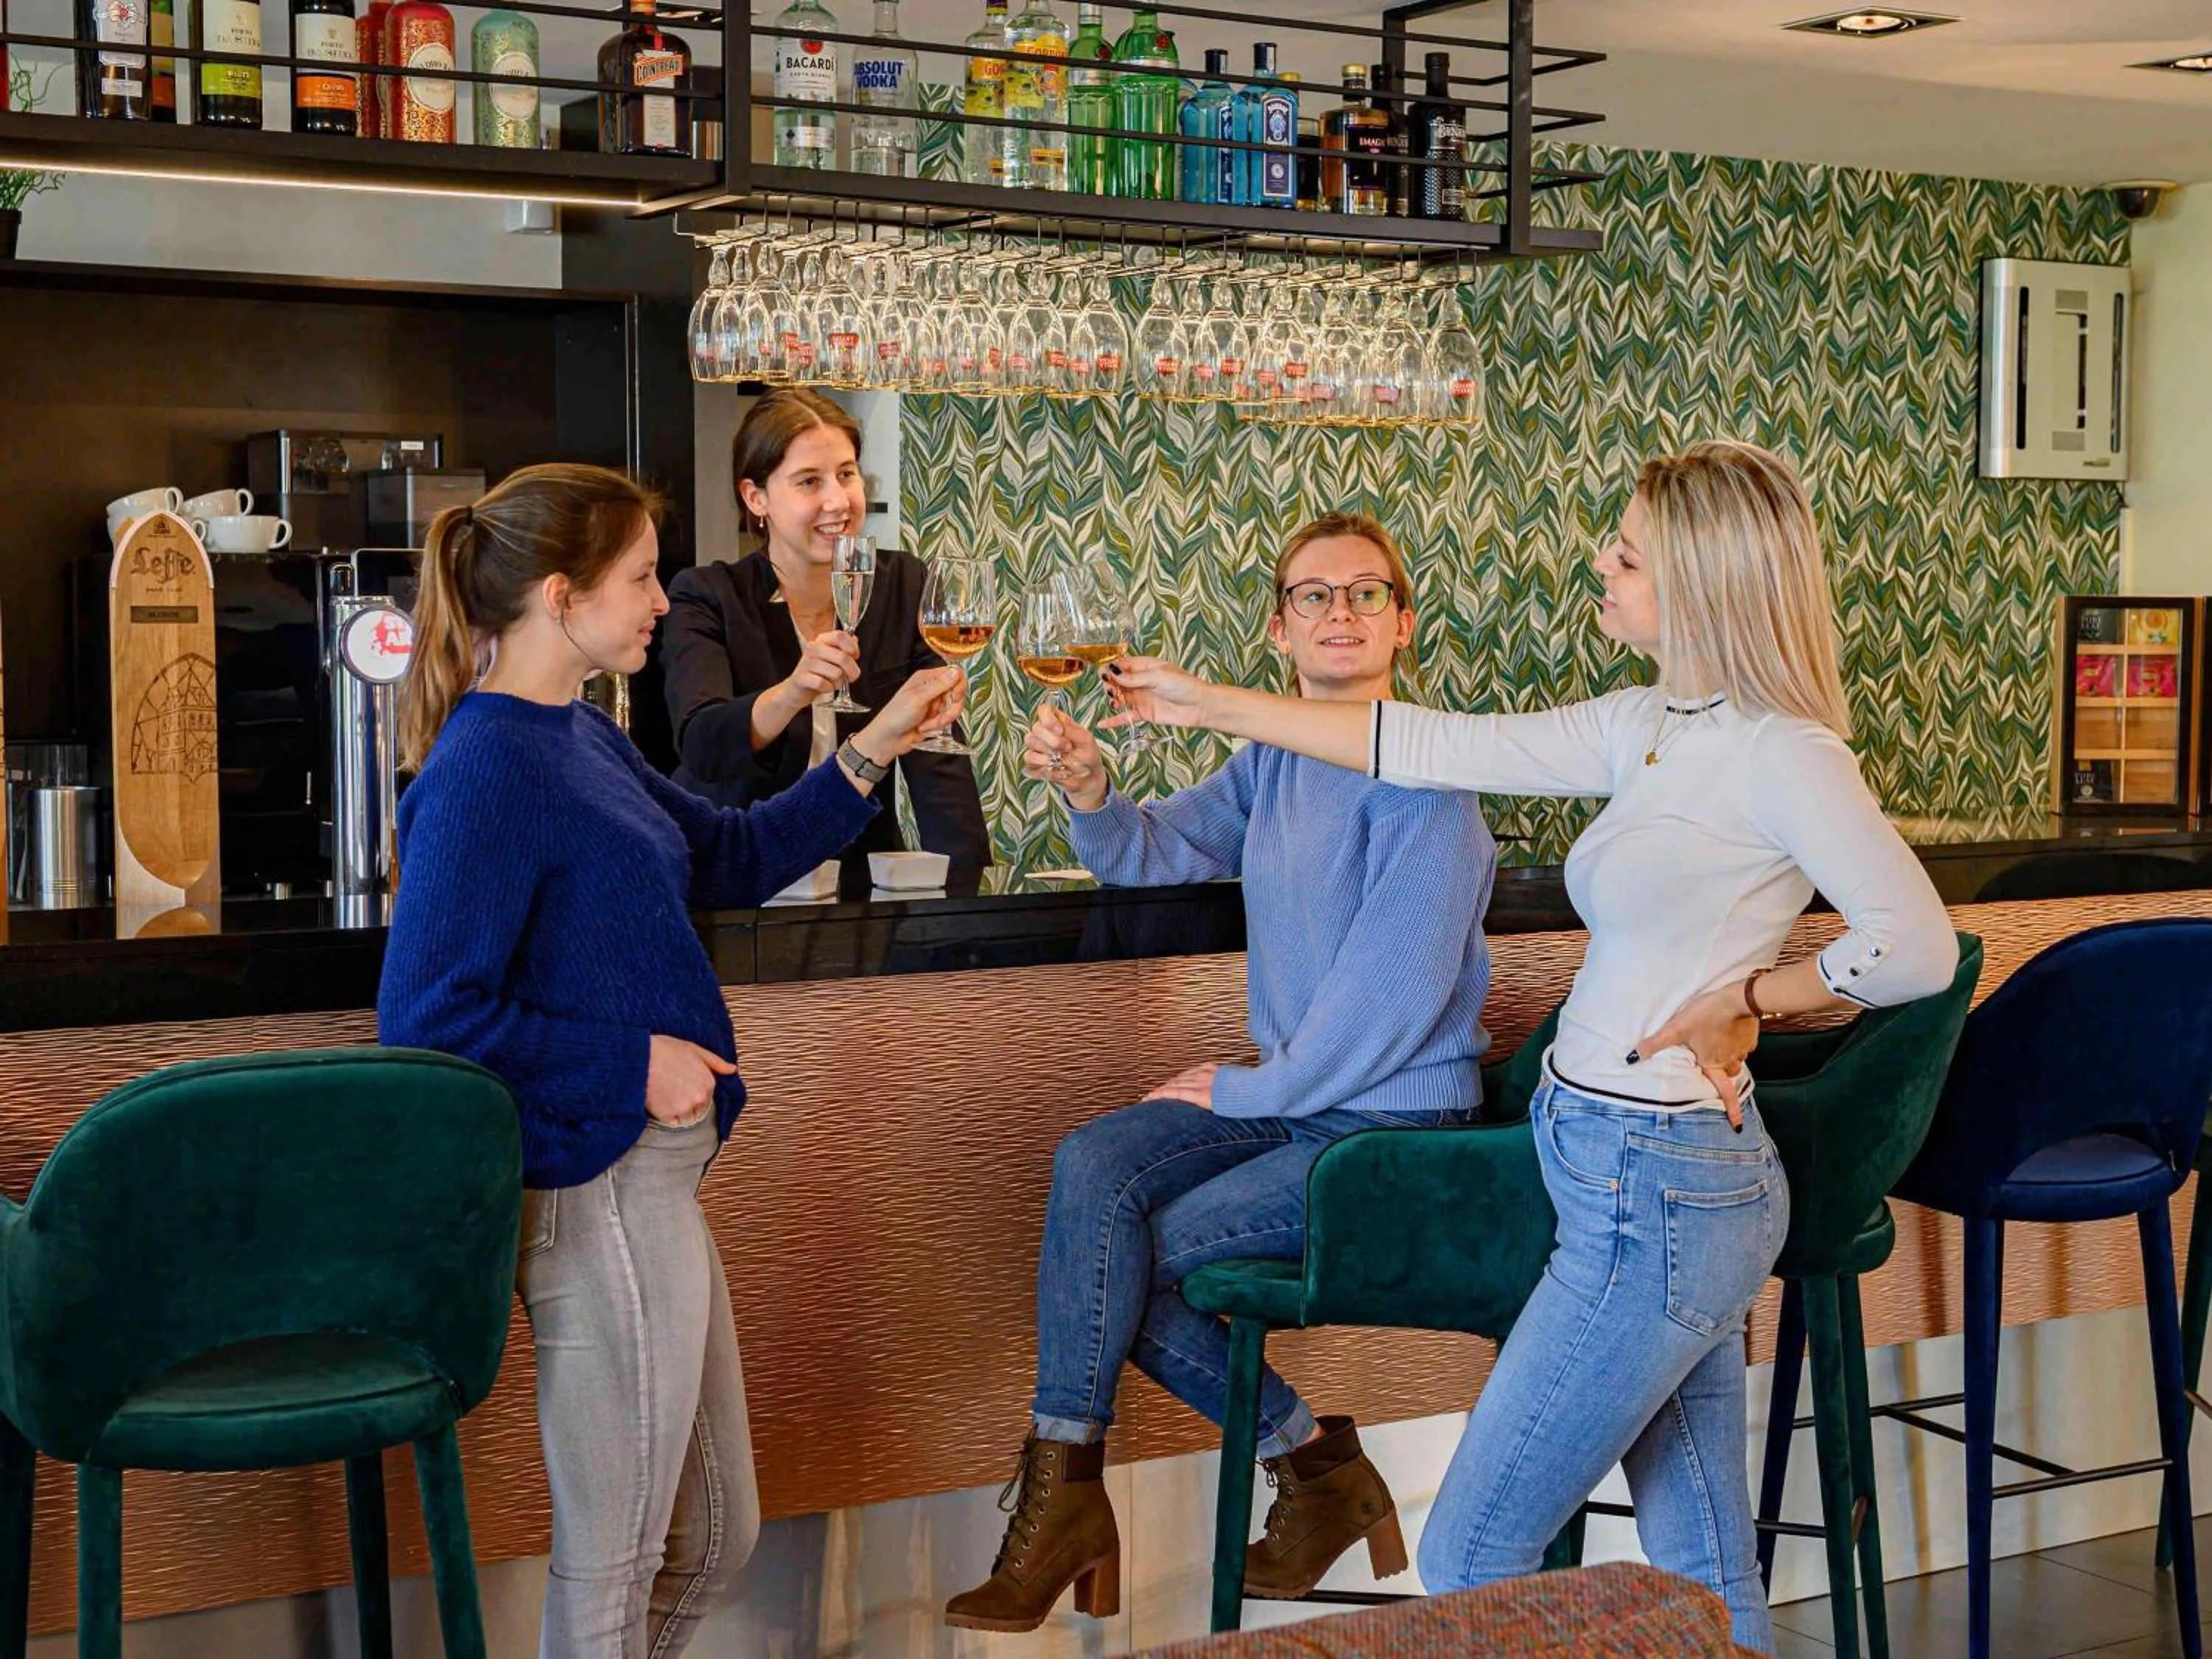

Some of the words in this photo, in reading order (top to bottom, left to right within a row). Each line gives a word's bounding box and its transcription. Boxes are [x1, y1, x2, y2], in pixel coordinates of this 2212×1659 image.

[854, 60, 903, 75] ABSOLUT
[857, 74, 897, 89] VODKA
[131, 546, 195, 584] Leffe
